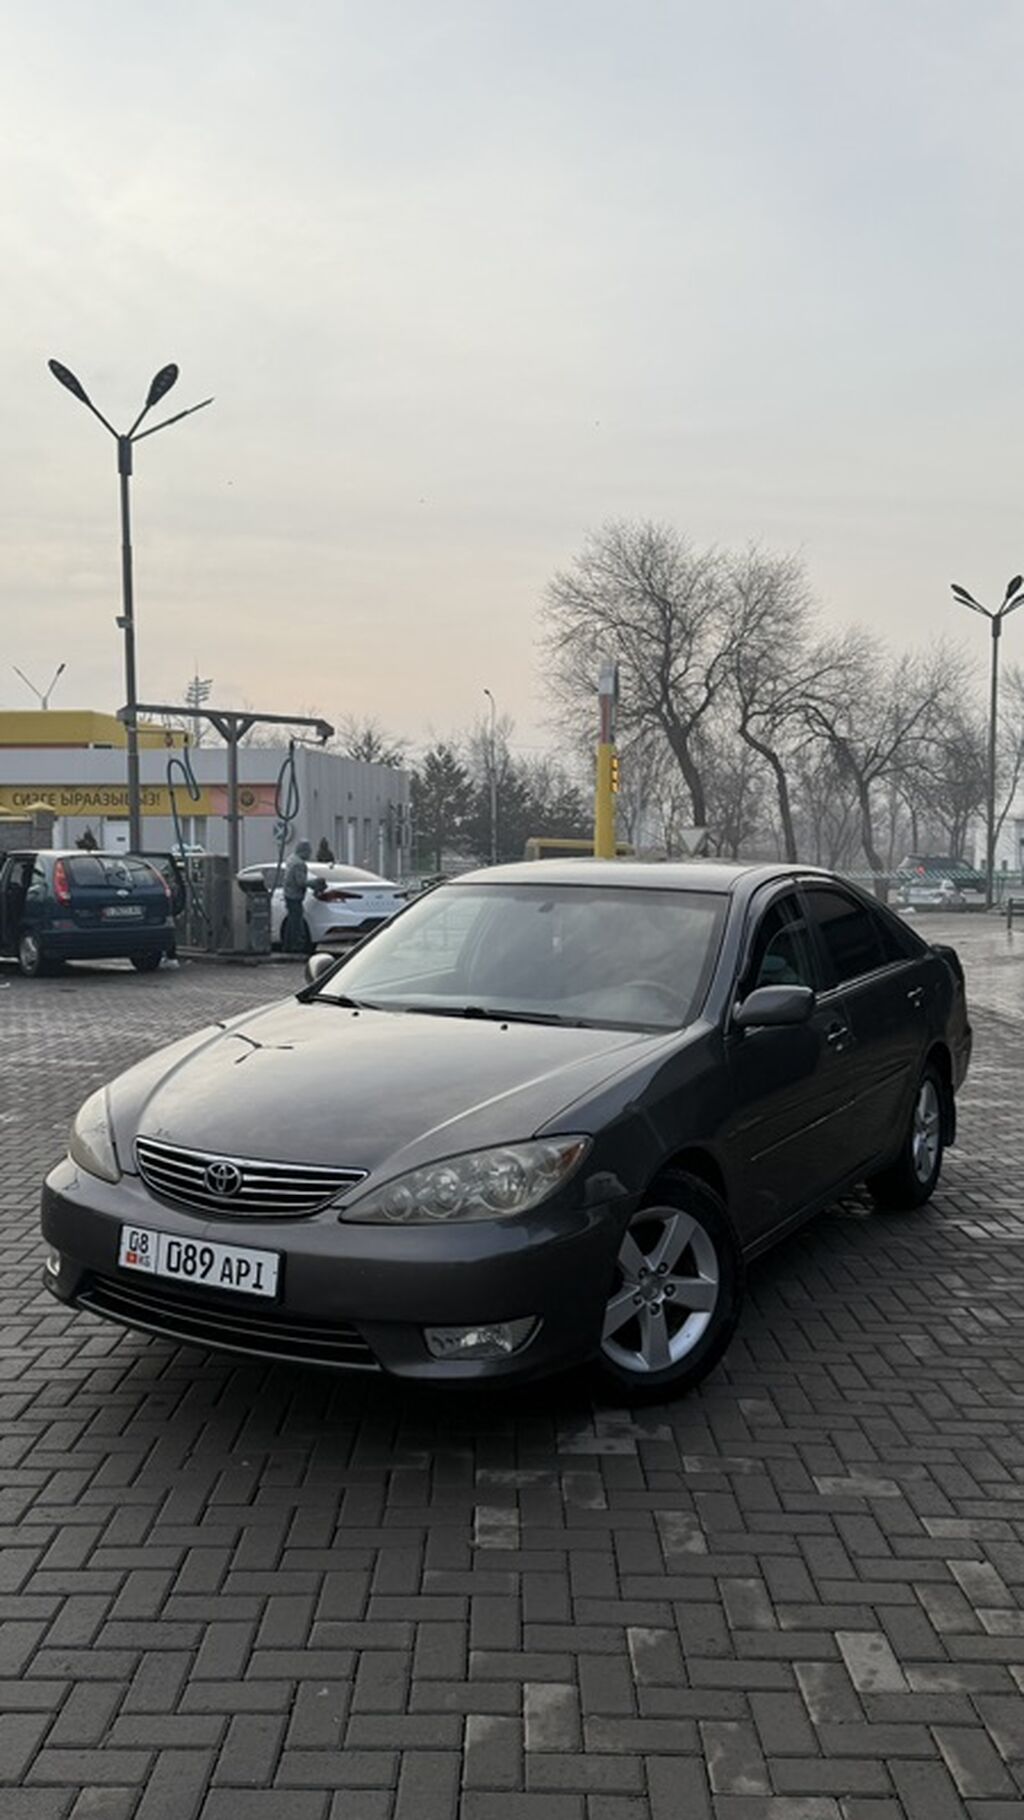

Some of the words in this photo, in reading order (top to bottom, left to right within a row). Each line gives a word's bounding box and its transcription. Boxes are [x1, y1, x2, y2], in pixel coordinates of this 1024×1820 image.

[129, 1230, 149, 1254] 08
[166, 1241, 215, 1279] 089
[219, 1257, 264, 1290] API
